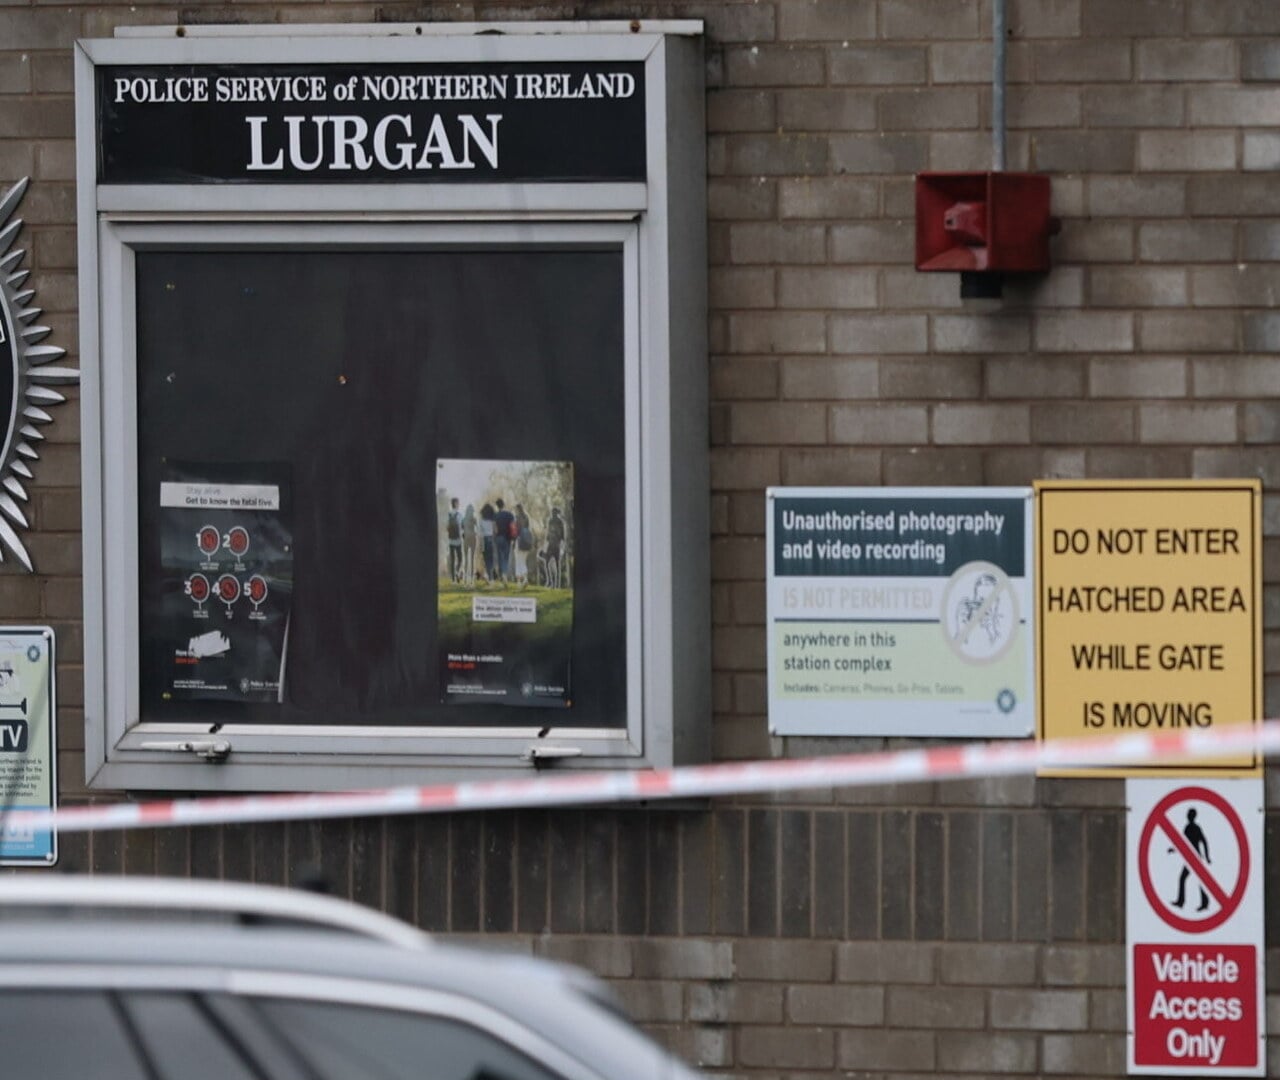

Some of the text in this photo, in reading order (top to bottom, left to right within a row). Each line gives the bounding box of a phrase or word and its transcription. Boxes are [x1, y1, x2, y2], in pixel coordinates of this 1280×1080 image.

[114, 72, 636, 104] POLICE SERVICE of NORTHERN IRELAND
[245, 113, 503, 171] LURGAN
[782, 510, 1005, 535] Unauthorised photography
[222, 534, 231, 548] 2
[782, 540, 946, 564] and video recording
[1053, 528, 1240, 555] DO NOT ENTER
[184, 580, 252, 596] 3 4 5
[783, 586, 933, 610] IS NOT PERMITTED
[1047, 586, 1246, 613] HATCHED AREA
[783, 630, 896, 649] anywhere in this
[784, 656, 892, 674] station complex
[1071, 645, 1225, 671] WHILE GATE
[1083, 701, 1213, 729] IS MOVING
[1152, 952, 1239, 983] Vehicle
[1150, 990, 1242, 1020] Access
[1166, 1027, 1225, 1065] Only
